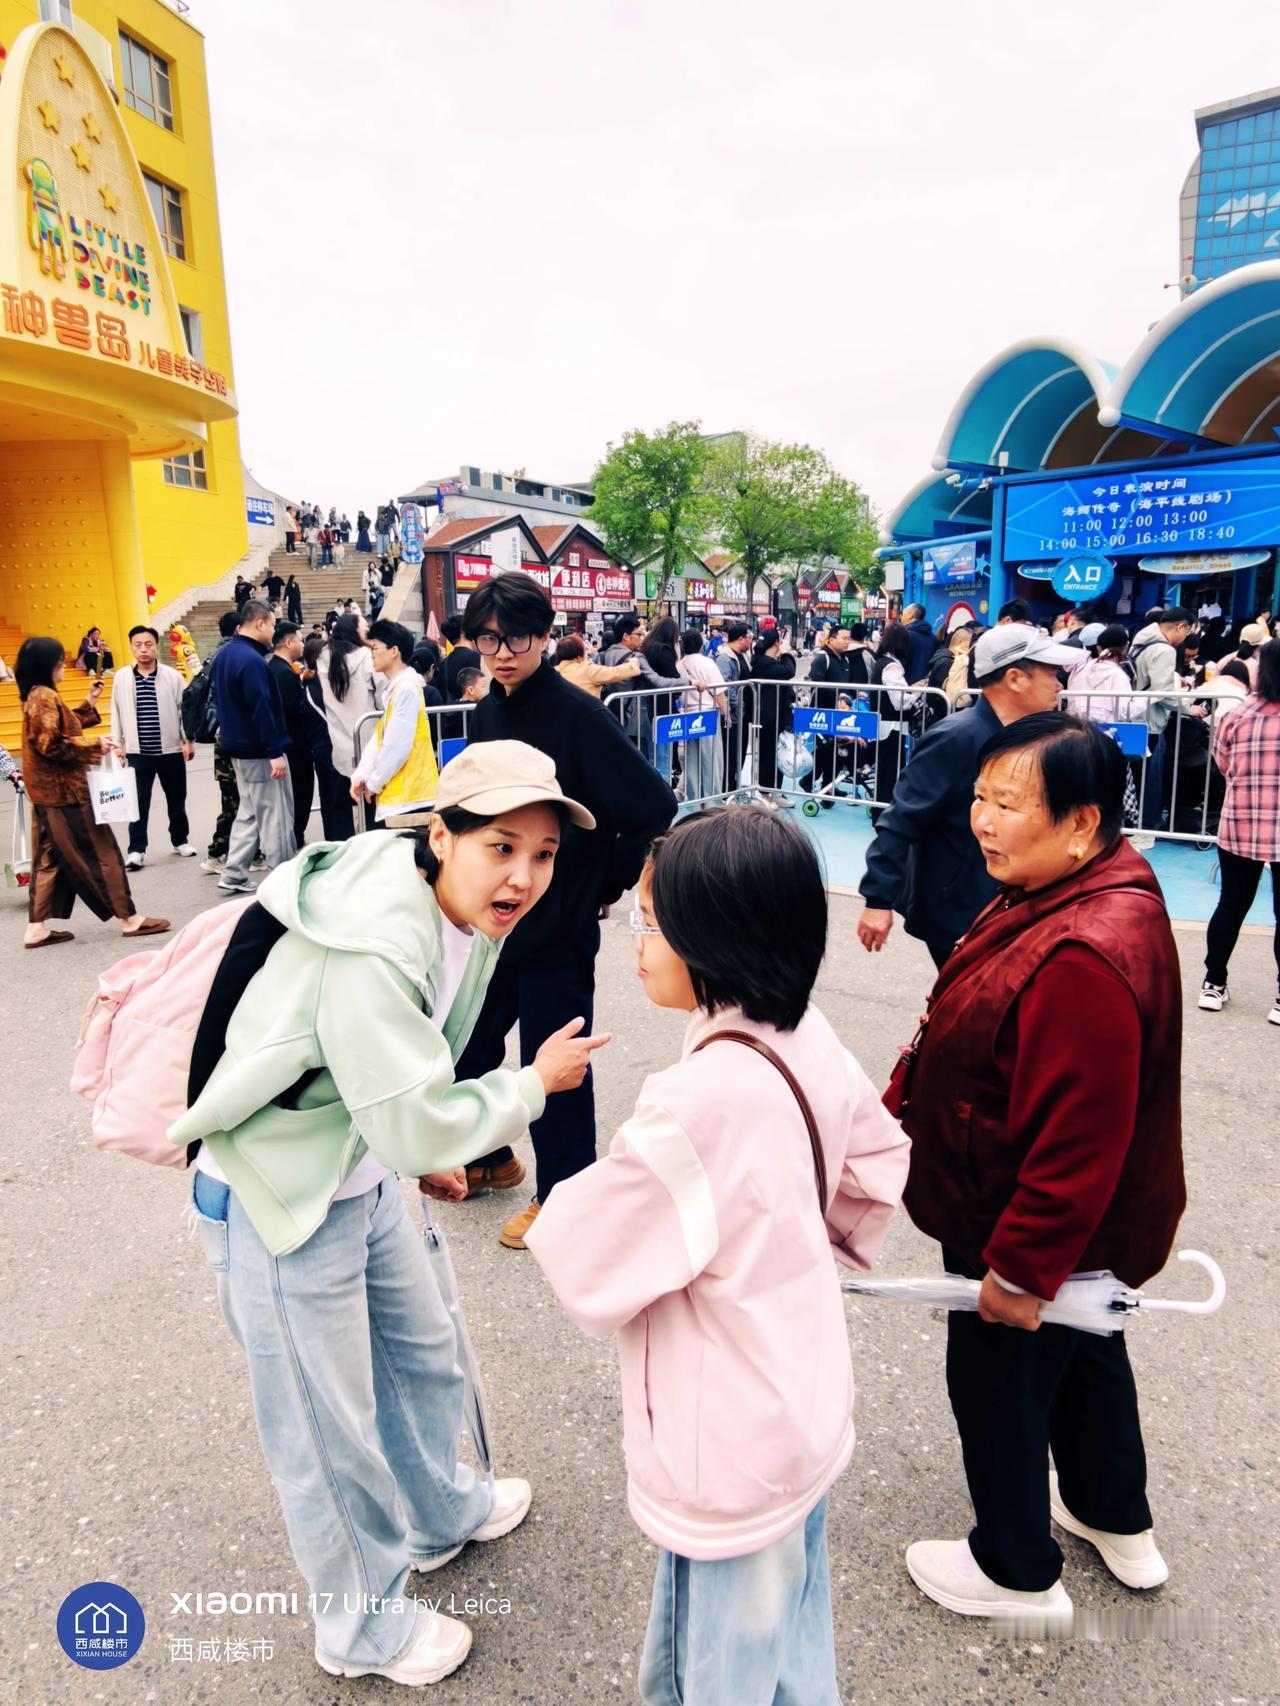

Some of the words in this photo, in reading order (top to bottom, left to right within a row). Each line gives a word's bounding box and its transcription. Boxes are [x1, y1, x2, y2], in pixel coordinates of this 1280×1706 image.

[68, 211, 147, 266] LITTLE
[72, 239, 151, 292] DIVINE
[75, 267, 152, 315] BEAST
[0, 282, 131, 361] 神兽岛
[139, 341, 227, 395] 儿童美学空间
[1092, 478, 1187, 498] 今日表演时间
[1063, 519, 1102, 533] 11:00
[1111, 515, 1153, 530] 12:00
[1163, 510, 1208, 526] 13:00
[1039, 538, 1077, 551] 14:00
[1086, 535, 1126, 548] 15:00
[1136, 531, 1178, 545] 16:30
[1189, 525, 1235, 541] 18:40
[561, 569, 591, 588] 便利店
[1064, 564, 1101, 583] 入口
[1063, 583, 1098, 591] ENTRANCE
[100, 793, 124, 804] Better
